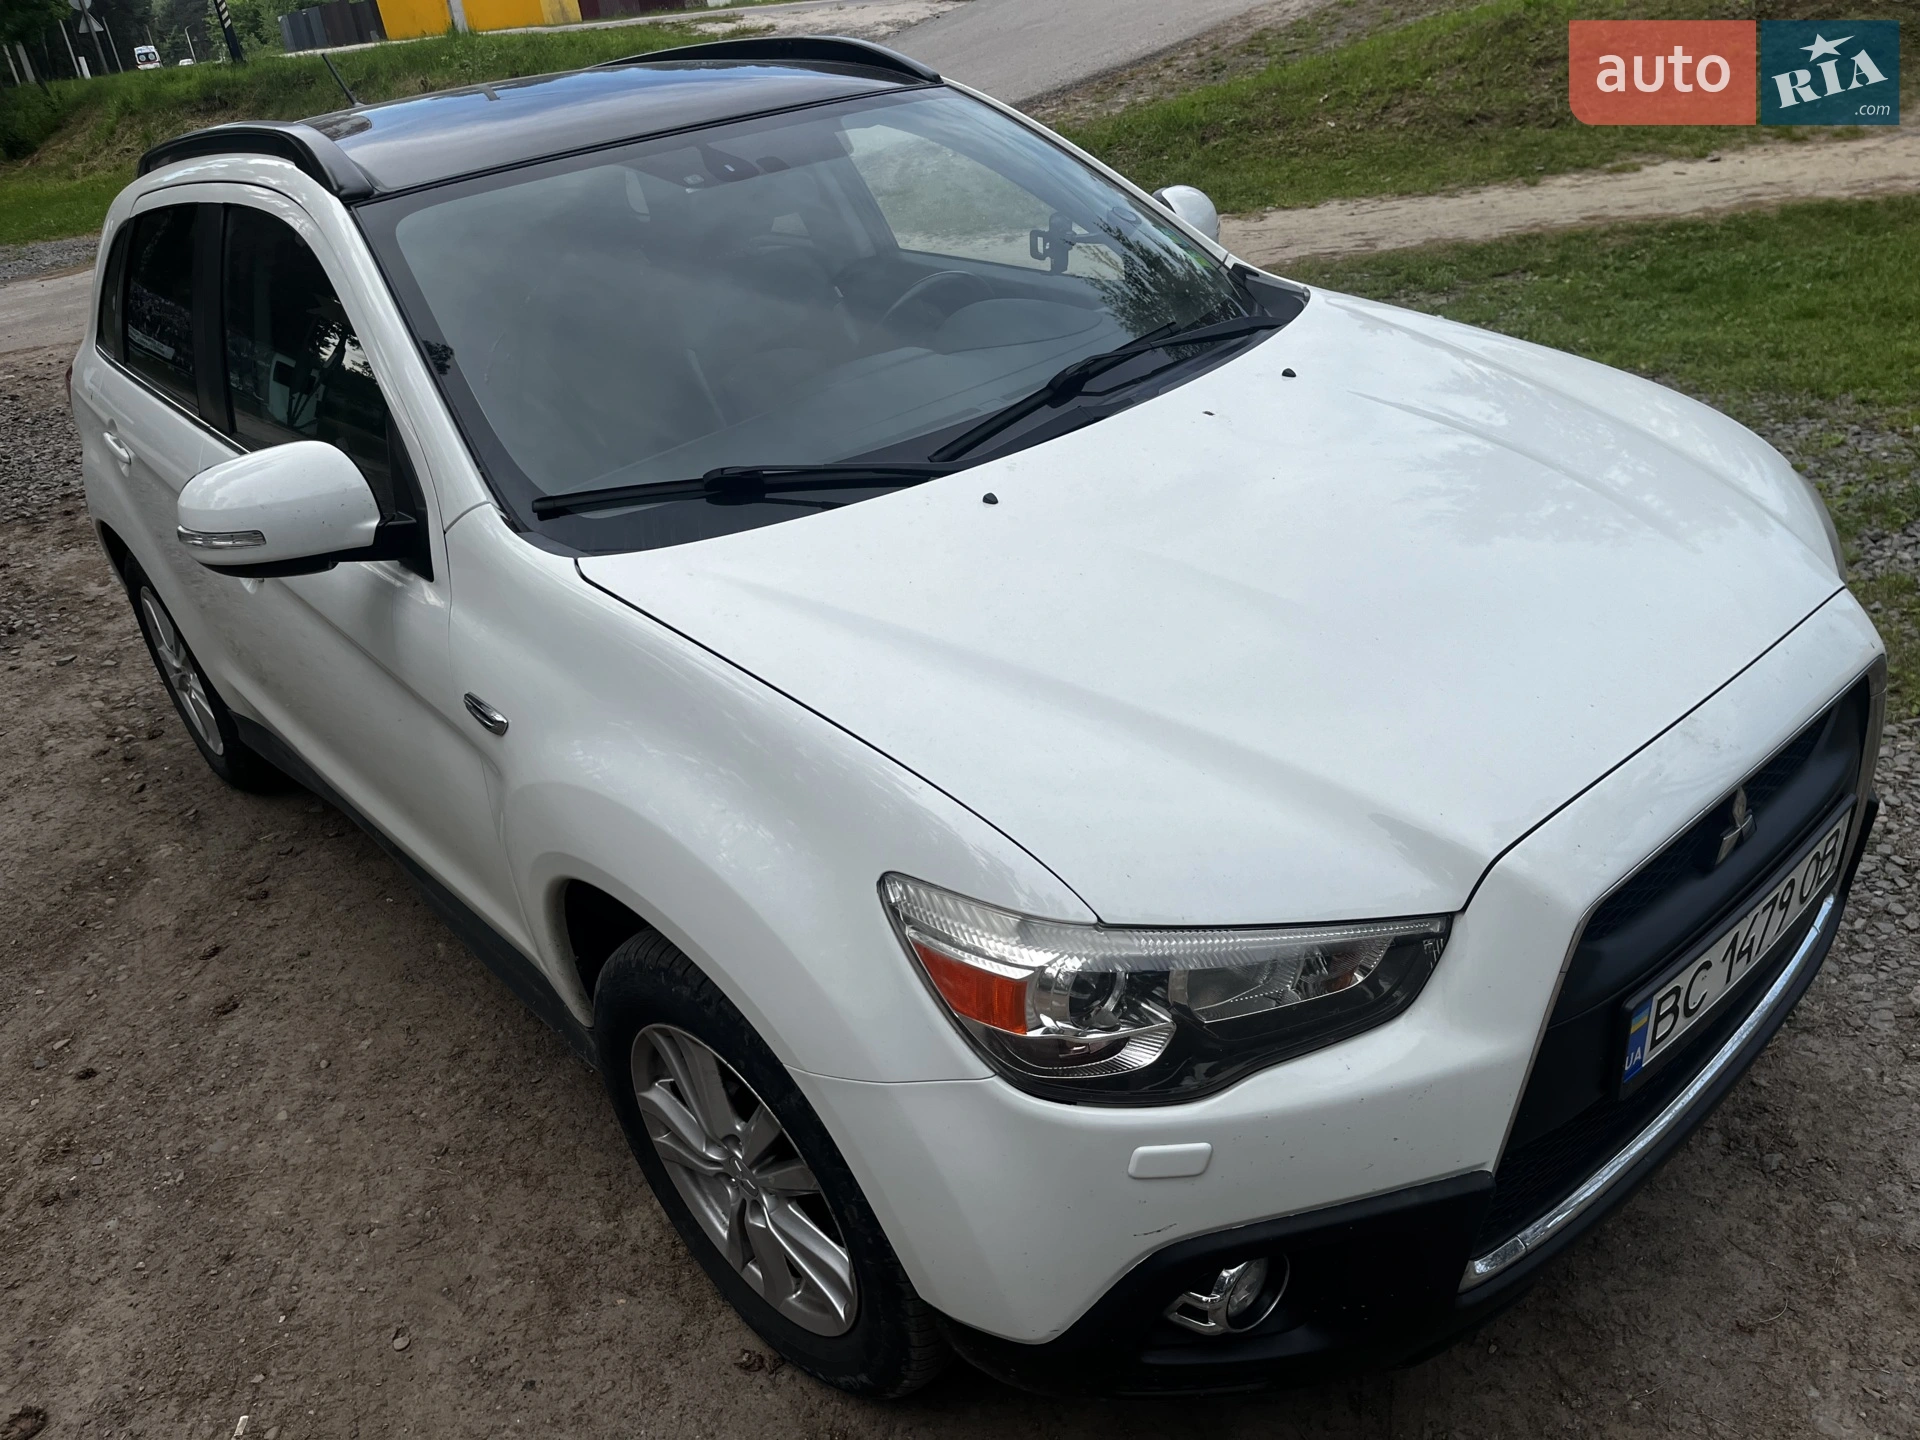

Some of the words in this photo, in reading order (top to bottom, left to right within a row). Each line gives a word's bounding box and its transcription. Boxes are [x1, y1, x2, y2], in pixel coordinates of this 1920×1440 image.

[1649, 960, 1713, 1052] BC
[1720, 878, 1796, 985] 1479
[1800, 827, 1840, 905] OB
[1624, 1046, 1642, 1071] UA
